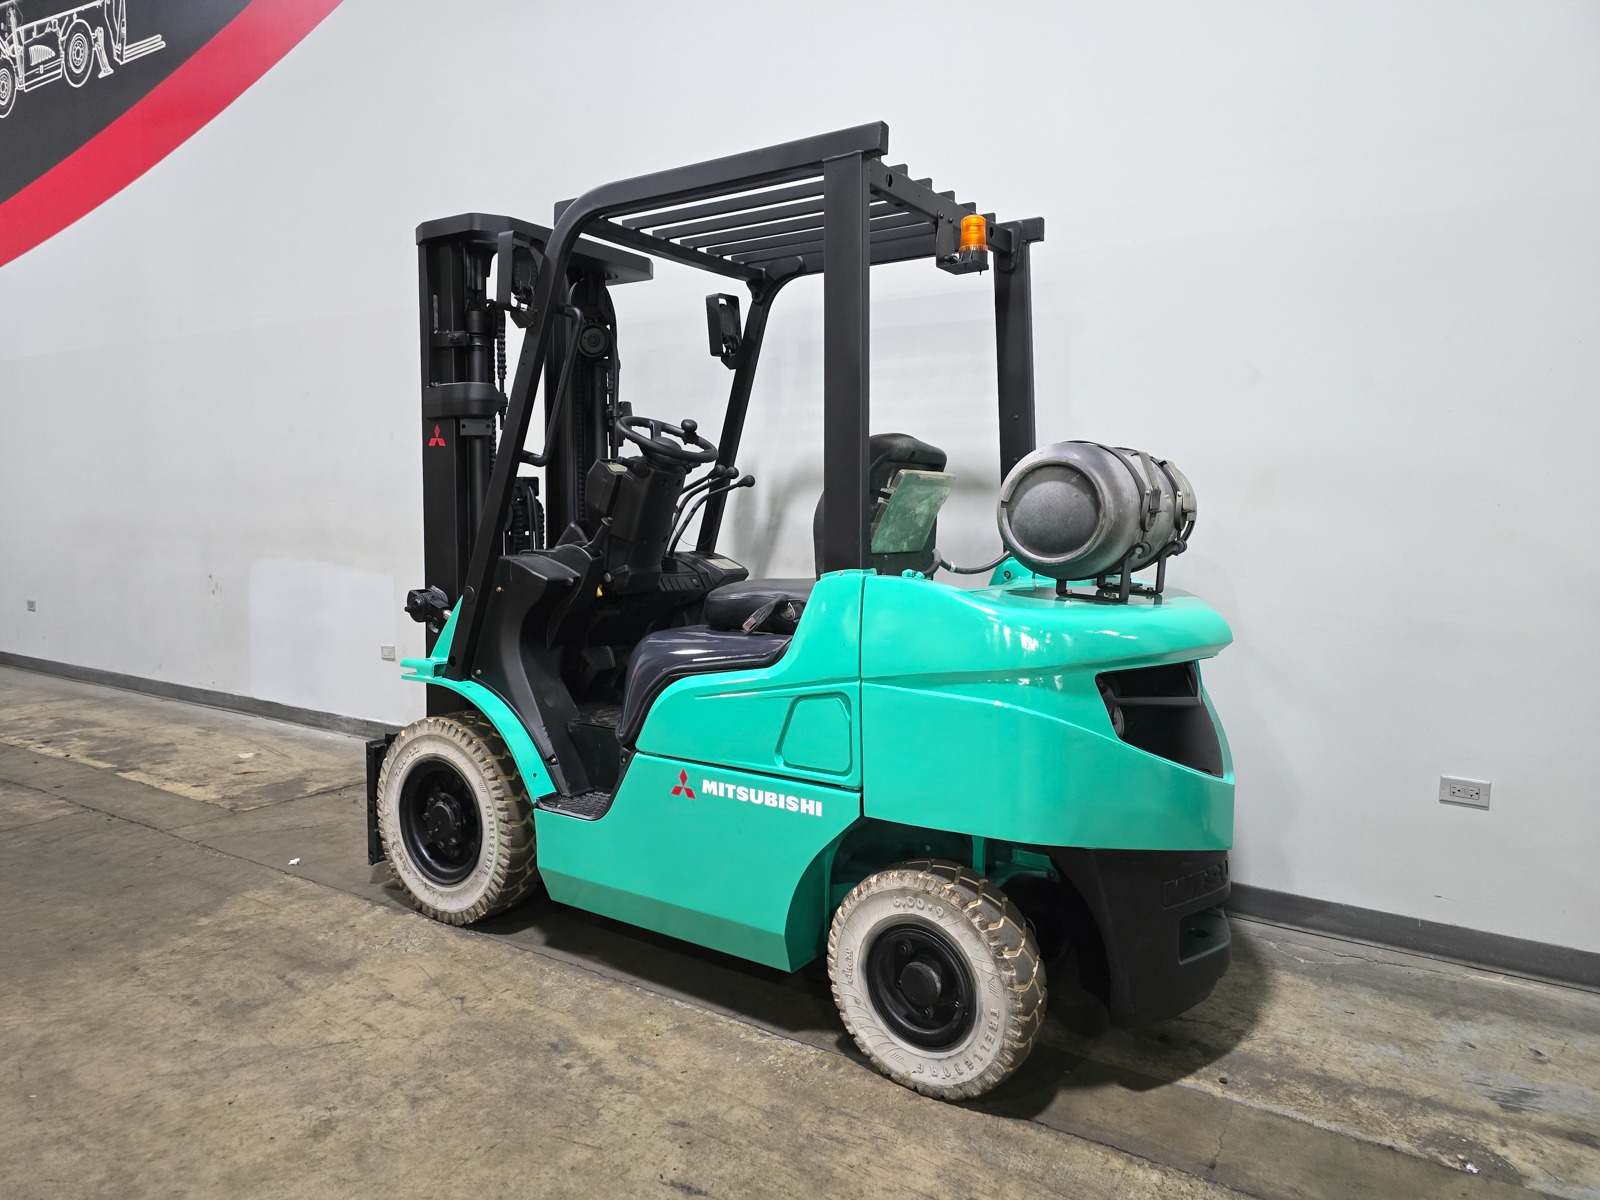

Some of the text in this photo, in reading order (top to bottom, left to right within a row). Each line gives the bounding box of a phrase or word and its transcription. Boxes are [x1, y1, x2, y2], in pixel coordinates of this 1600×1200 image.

[701, 779, 823, 817] MITSUBISHI
[892, 895, 945, 918] 6.00-9
[916, 1007, 1000, 1078] TRELLEBORG
